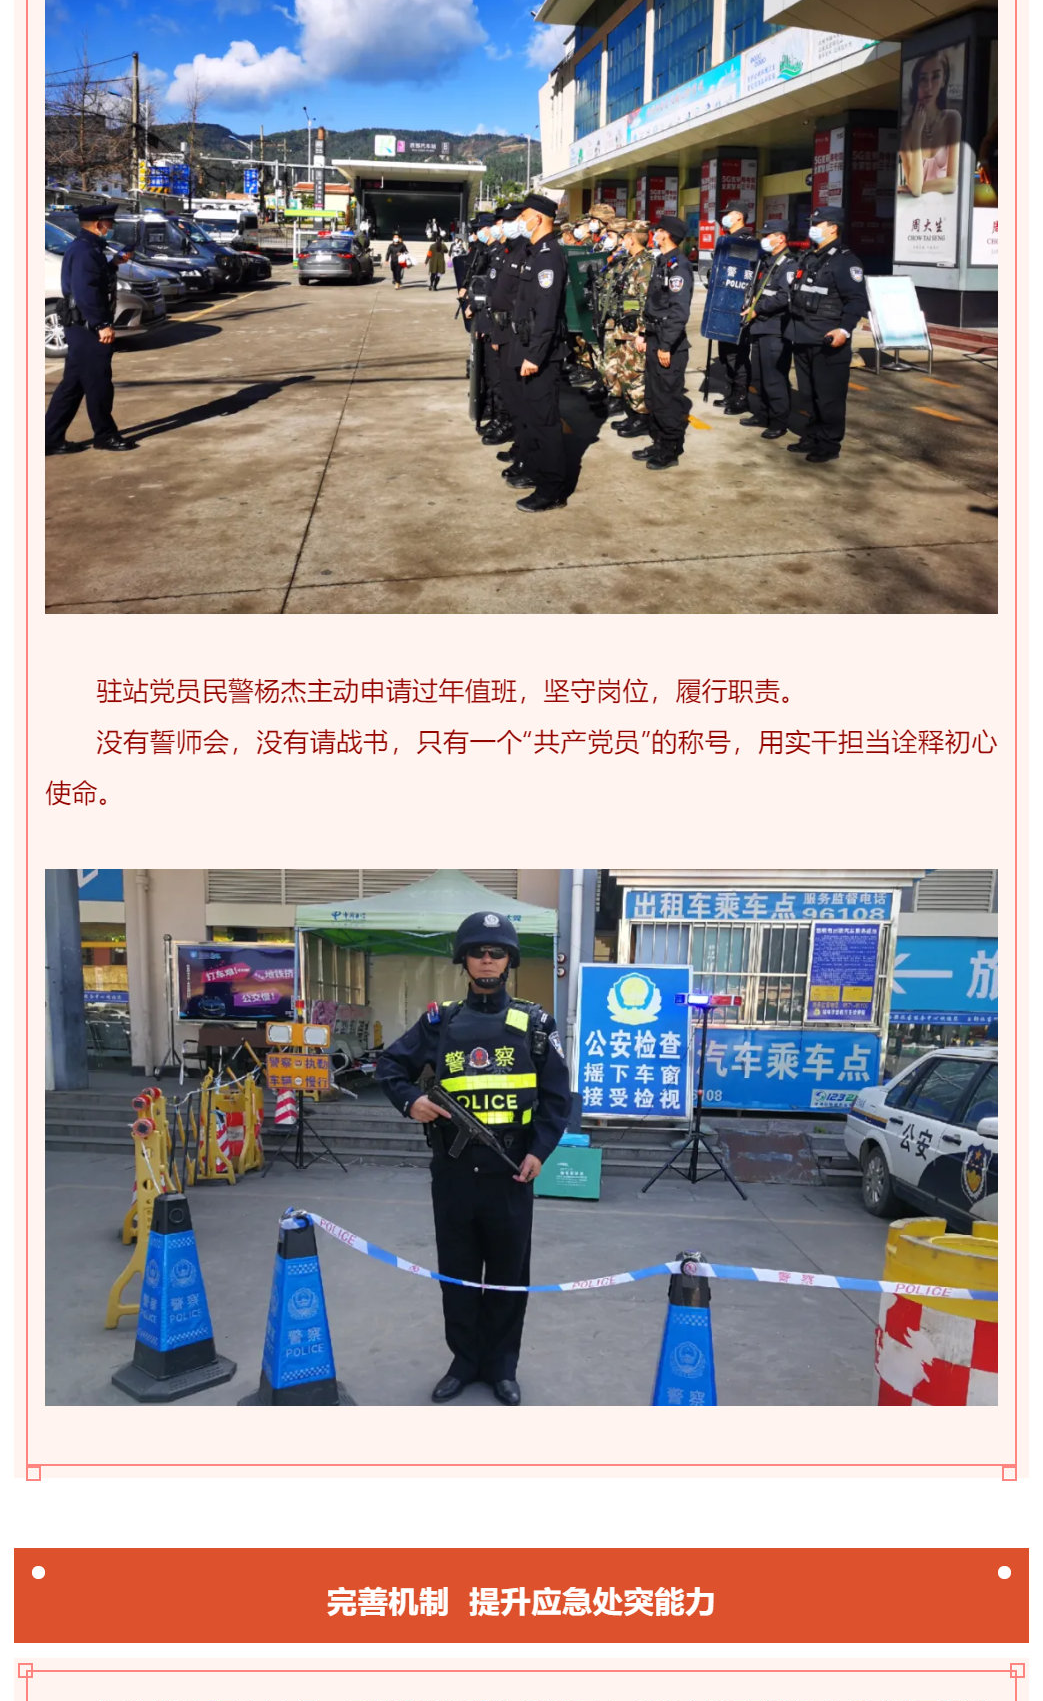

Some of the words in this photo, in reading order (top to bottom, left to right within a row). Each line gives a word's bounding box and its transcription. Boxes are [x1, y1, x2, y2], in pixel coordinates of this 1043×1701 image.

[911, 217, 943, 233] 周大生
[725, 278, 749, 290] POLIC
[96, 677, 793, 705] 驻站党员民警杨杰主动申请过年值班，坚守岗位，履行职责。
[45, 779, 110, 807] 使命。
[633, 892, 797, 920] 出租车乘车点
[803, 891, 888, 905] 服务监督电话
[802, 907, 886, 921] 96108
[585, 1029, 682, 1060] 公安检查
[445, 1046, 515, 1074] 警察
[583, 1062, 681, 1086] 摇下车窗
[456, 1094, 519, 1110] OLICE
[582, 1086, 681, 1110] 接受检视
[900, 1123, 933, 1161] 公安
[894, 1283, 953, 1298] POLICE
[169, 1308, 202, 1323] POLICE
[288, 1327, 321, 1343] 警察
[286, 1343, 325, 1358] POLICE
[328, 1586, 449, 1617] 完善机制
[469, 1586, 715, 1617] 提升应急处突能力
